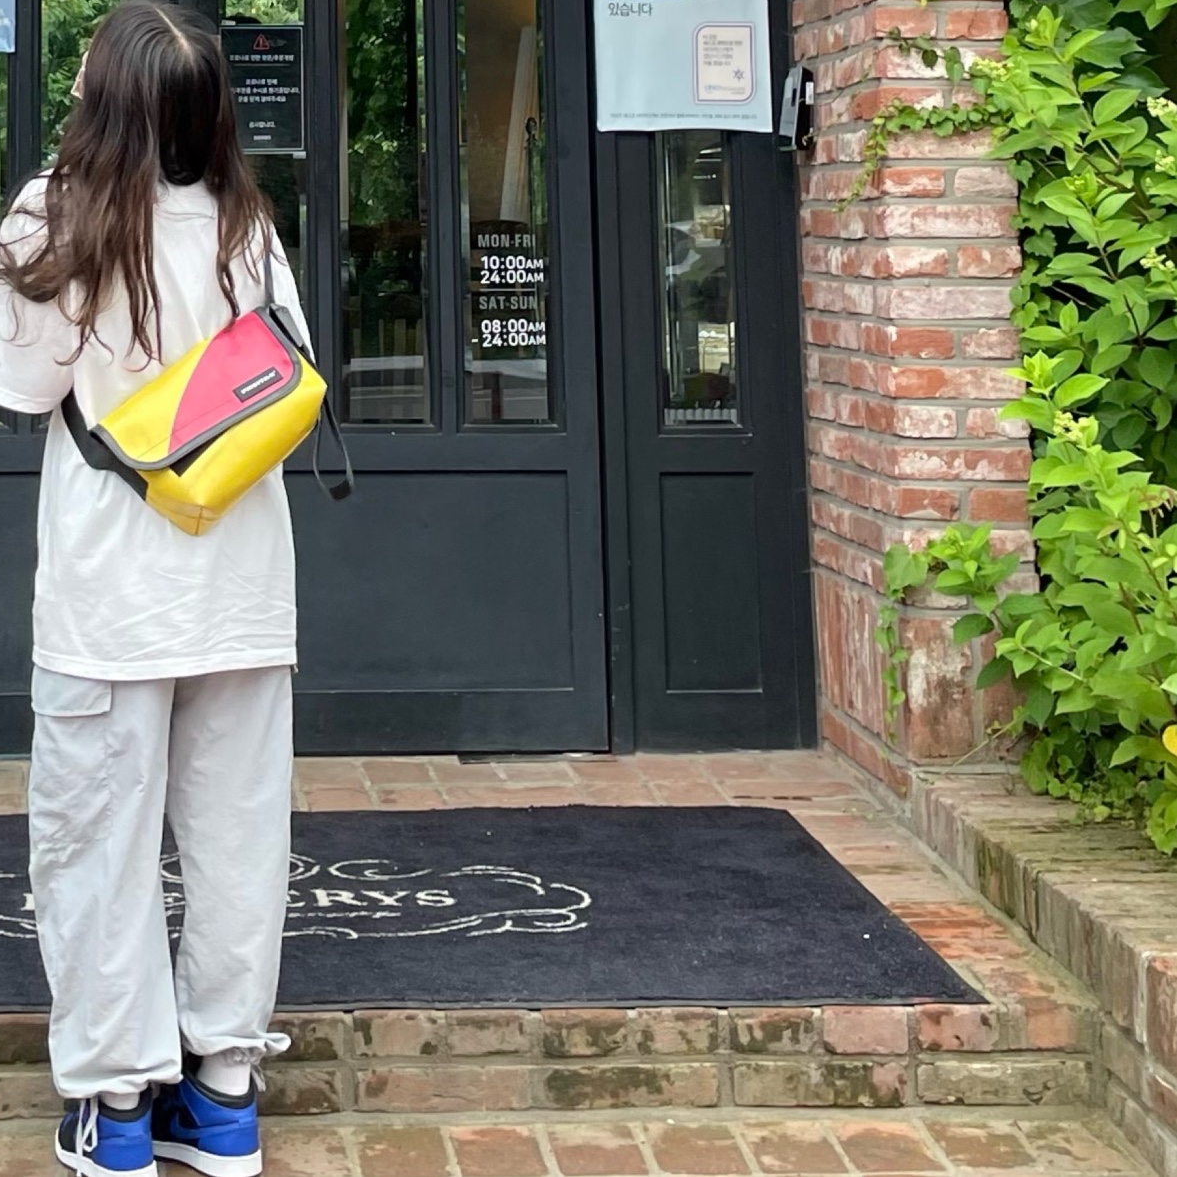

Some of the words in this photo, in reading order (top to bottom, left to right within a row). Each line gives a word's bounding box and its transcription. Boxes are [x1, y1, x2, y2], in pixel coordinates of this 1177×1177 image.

[608, 2, 653, 16] 있습니다
[480, 255, 544, 270] 10:00AM
[480, 270, 544, 284] 24:00AM
[481, 319, 546, 334] 08:00AM
